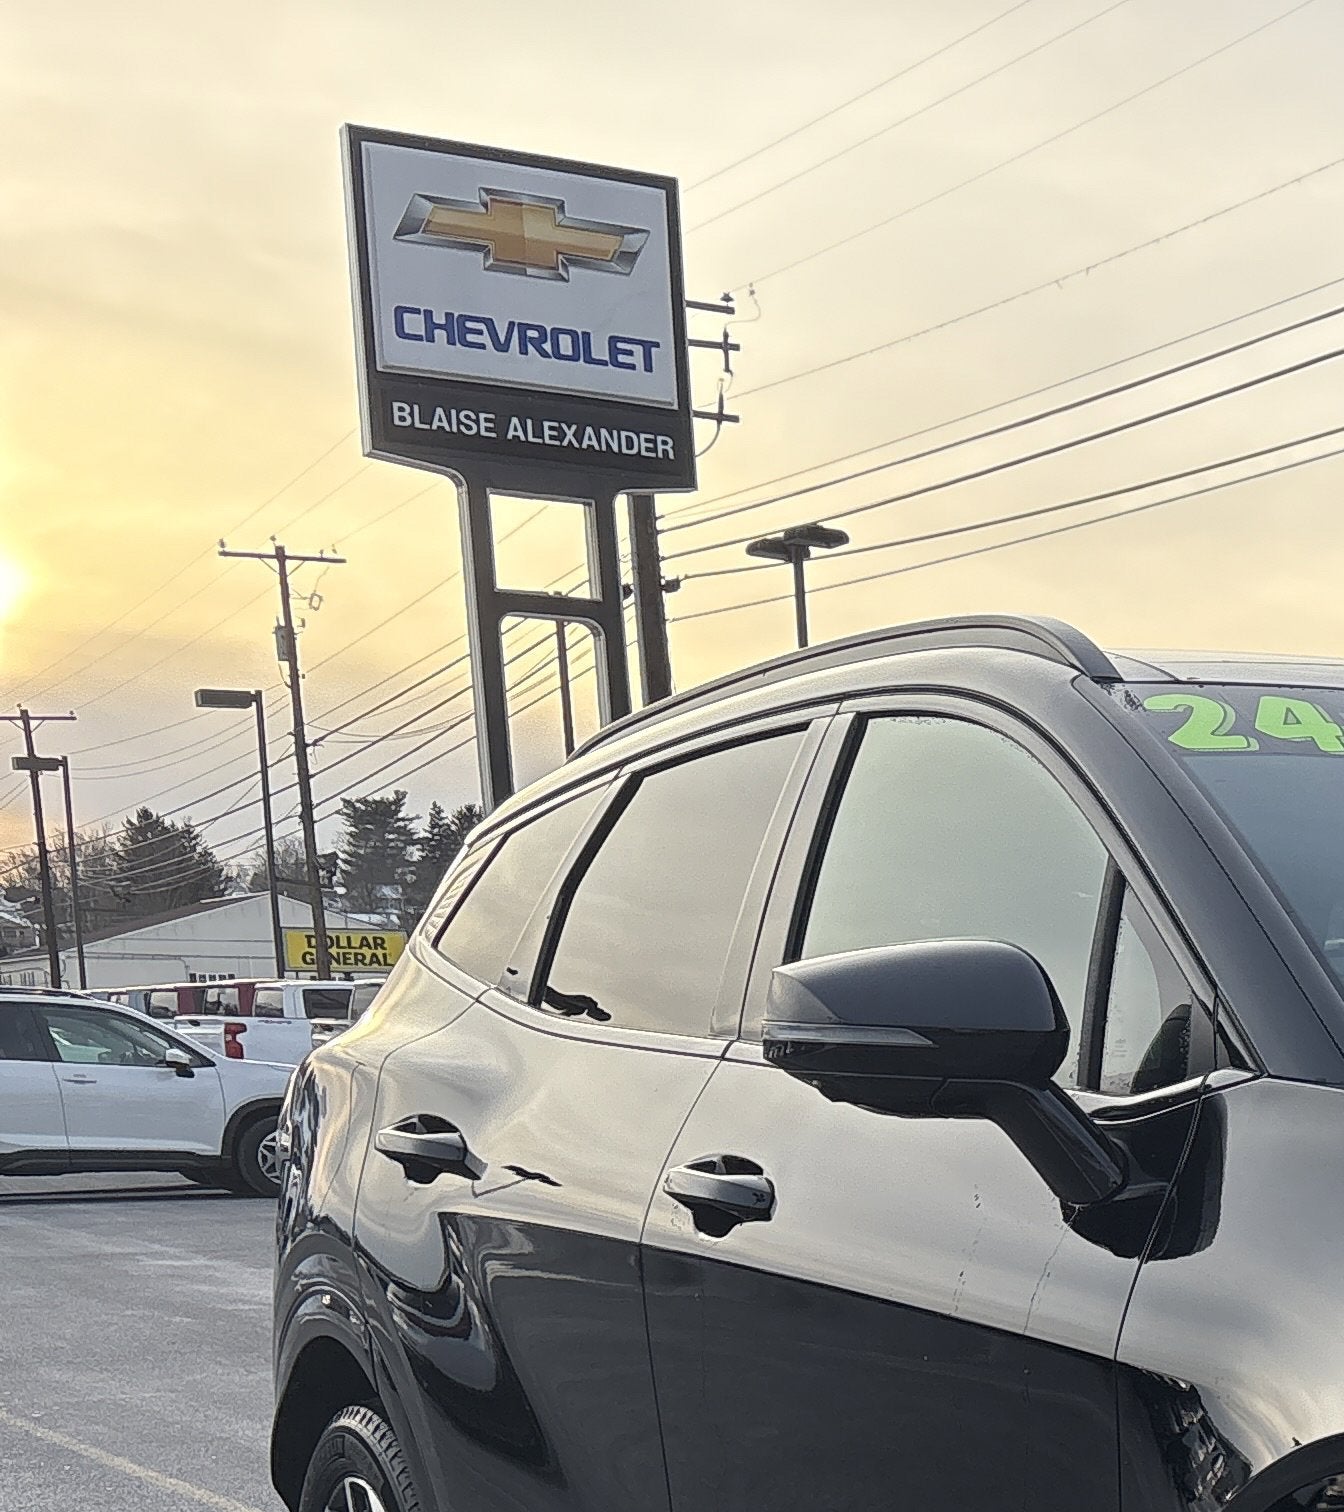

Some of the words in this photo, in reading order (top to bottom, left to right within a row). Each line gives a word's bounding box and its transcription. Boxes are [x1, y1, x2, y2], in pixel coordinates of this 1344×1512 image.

[393, 304, 661, 373] CHEVROLET
[391, 401, 497, 439] BLAISE
[506, 417, 675, 460] ALEXANDER
[301, 951, 396, 966] GNERAL
